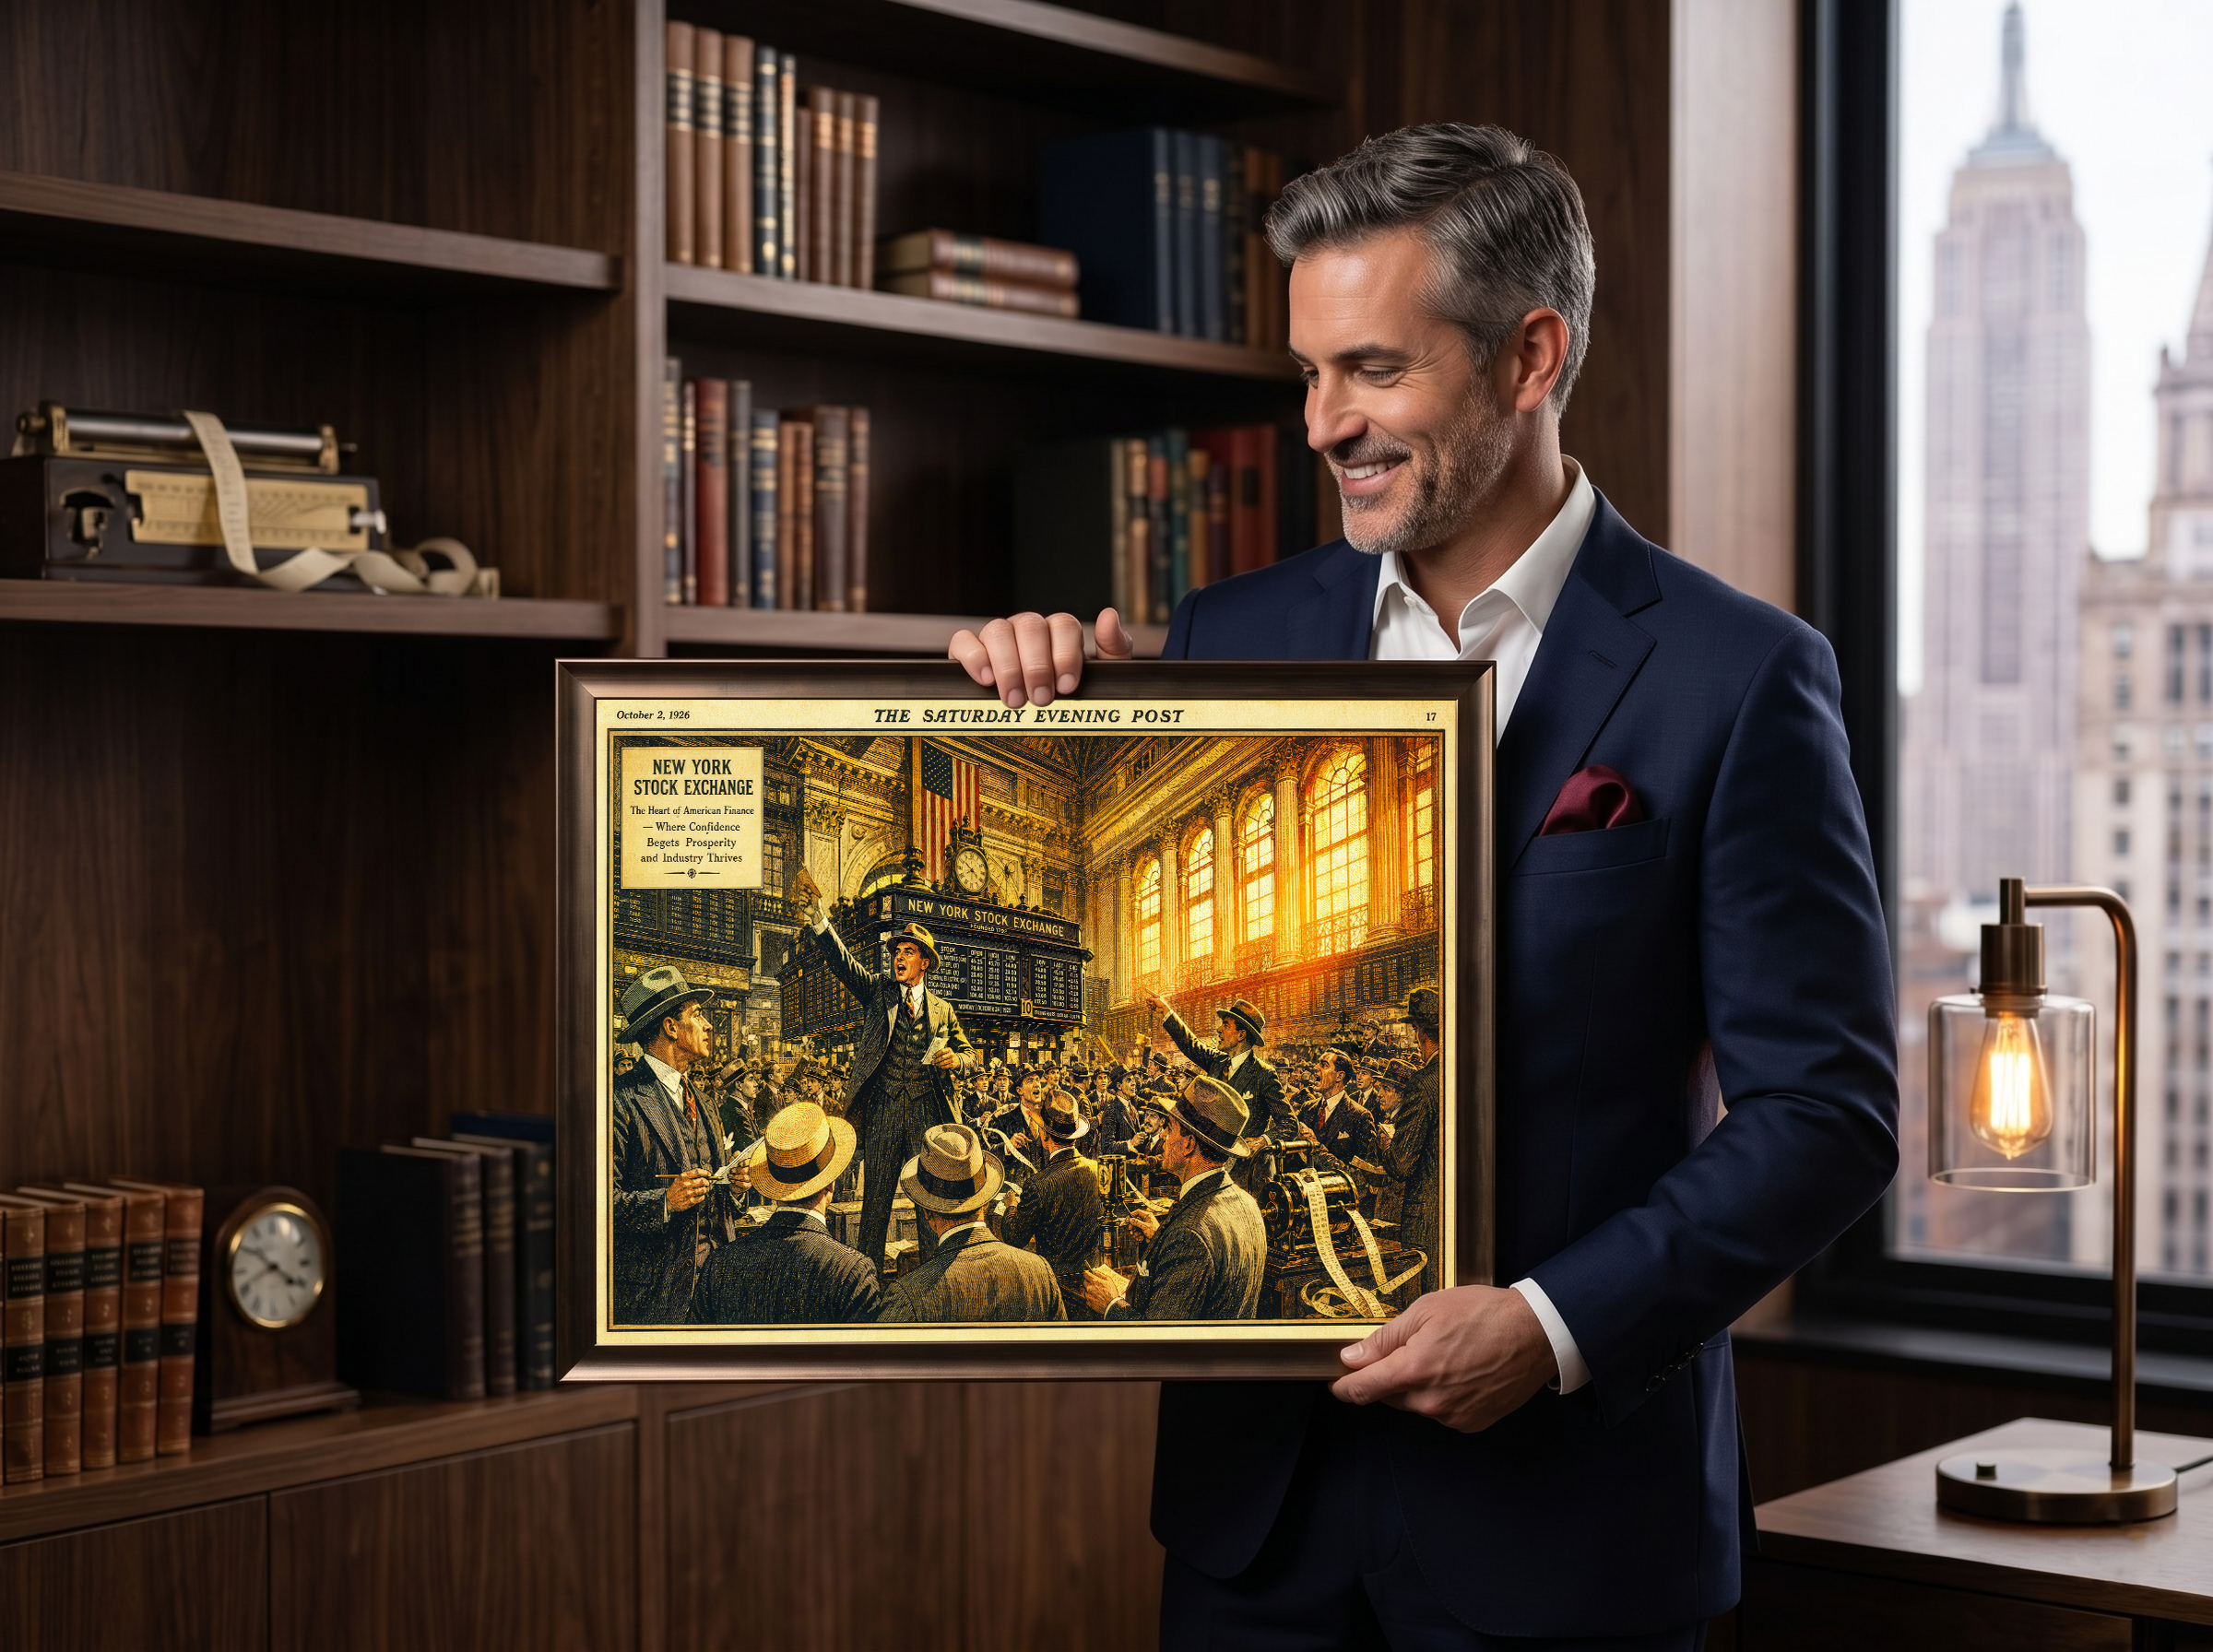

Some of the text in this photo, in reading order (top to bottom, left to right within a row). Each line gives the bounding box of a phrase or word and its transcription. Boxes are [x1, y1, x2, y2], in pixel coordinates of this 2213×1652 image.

[617, 711, 690, 720] October 2, 1926
[875, 709, 1185, 723] THE SATURDAY EVENING POST
[1426, 713, 1437, 721] 17
[653, 760, 731, 774] NEW YORK
[634, 780, 753, 795] STOCK EXCHANGE
[630, 806, 754, 814] The Heart of American Finance
[656, 822, 686, 831] Where
[689, 821, 740, 832] Confidence
[647, 838, 736, 849] Begets Prosperity
[641, 853, 742, 864] and Industry Thrives
[908, 899, 1063, 937] NEW YORK STOCK EXCHANGE
[970, 924, 994, 932] FOUNDED
[1023, 1001, 1031, 1013] 10
